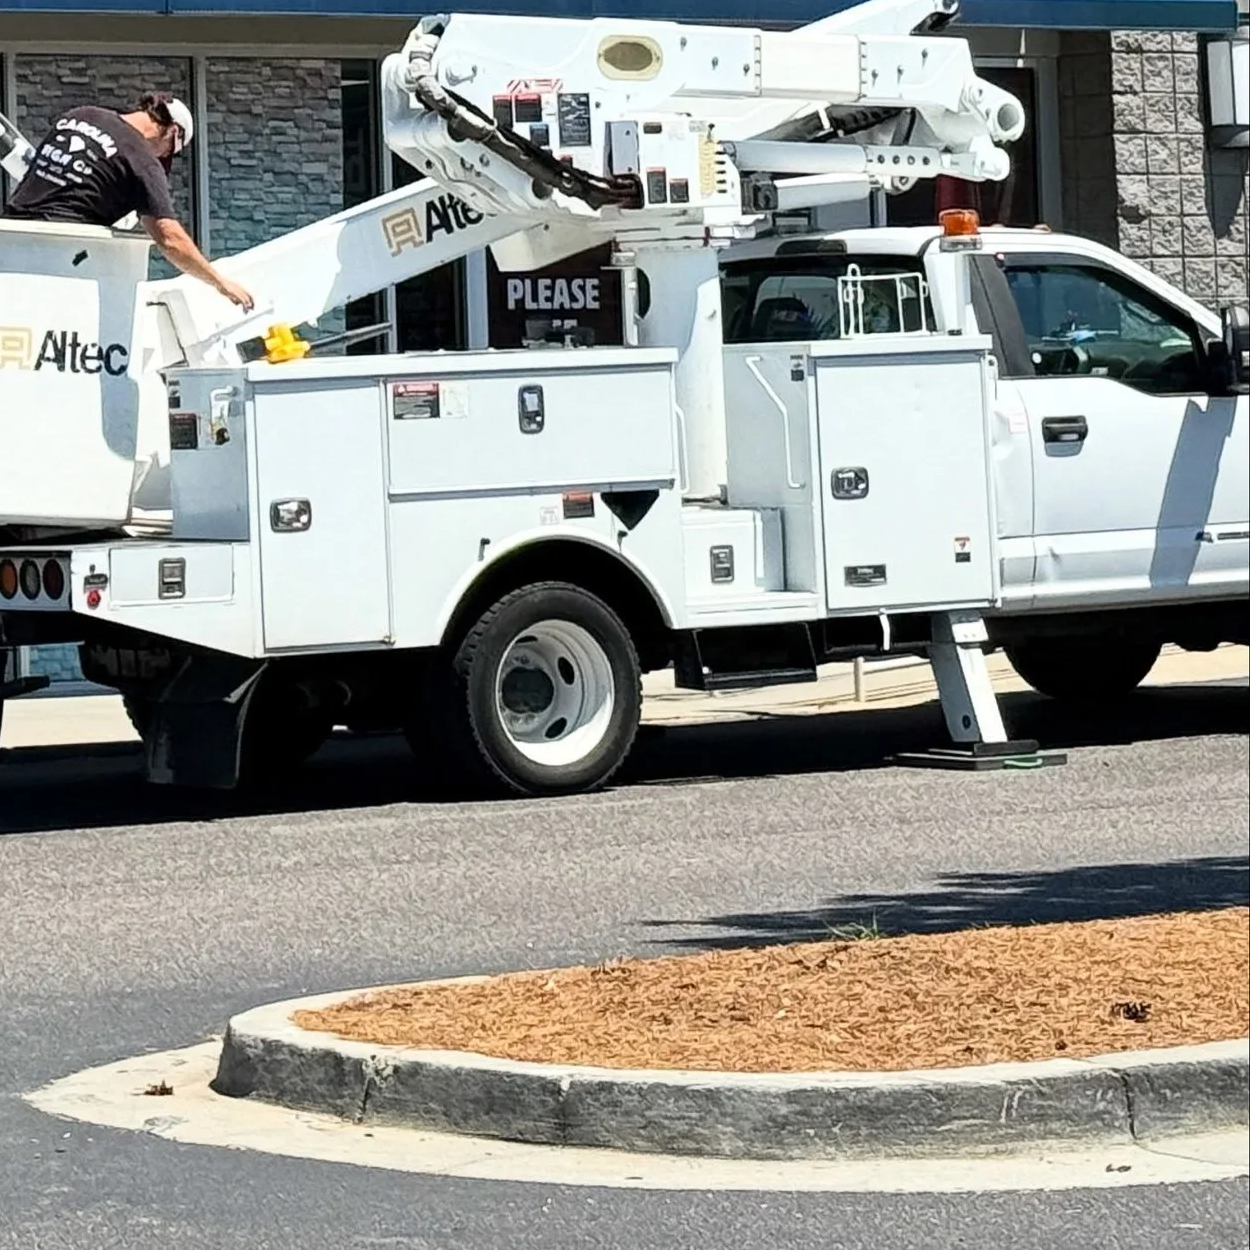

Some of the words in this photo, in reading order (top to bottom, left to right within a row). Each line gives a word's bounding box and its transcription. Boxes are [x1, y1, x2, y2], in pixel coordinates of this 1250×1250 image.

[425, 192, 498, 243] Alte
[507, 278, 600, 310] PLEASE
[34, 330, 128, 376] Altec
